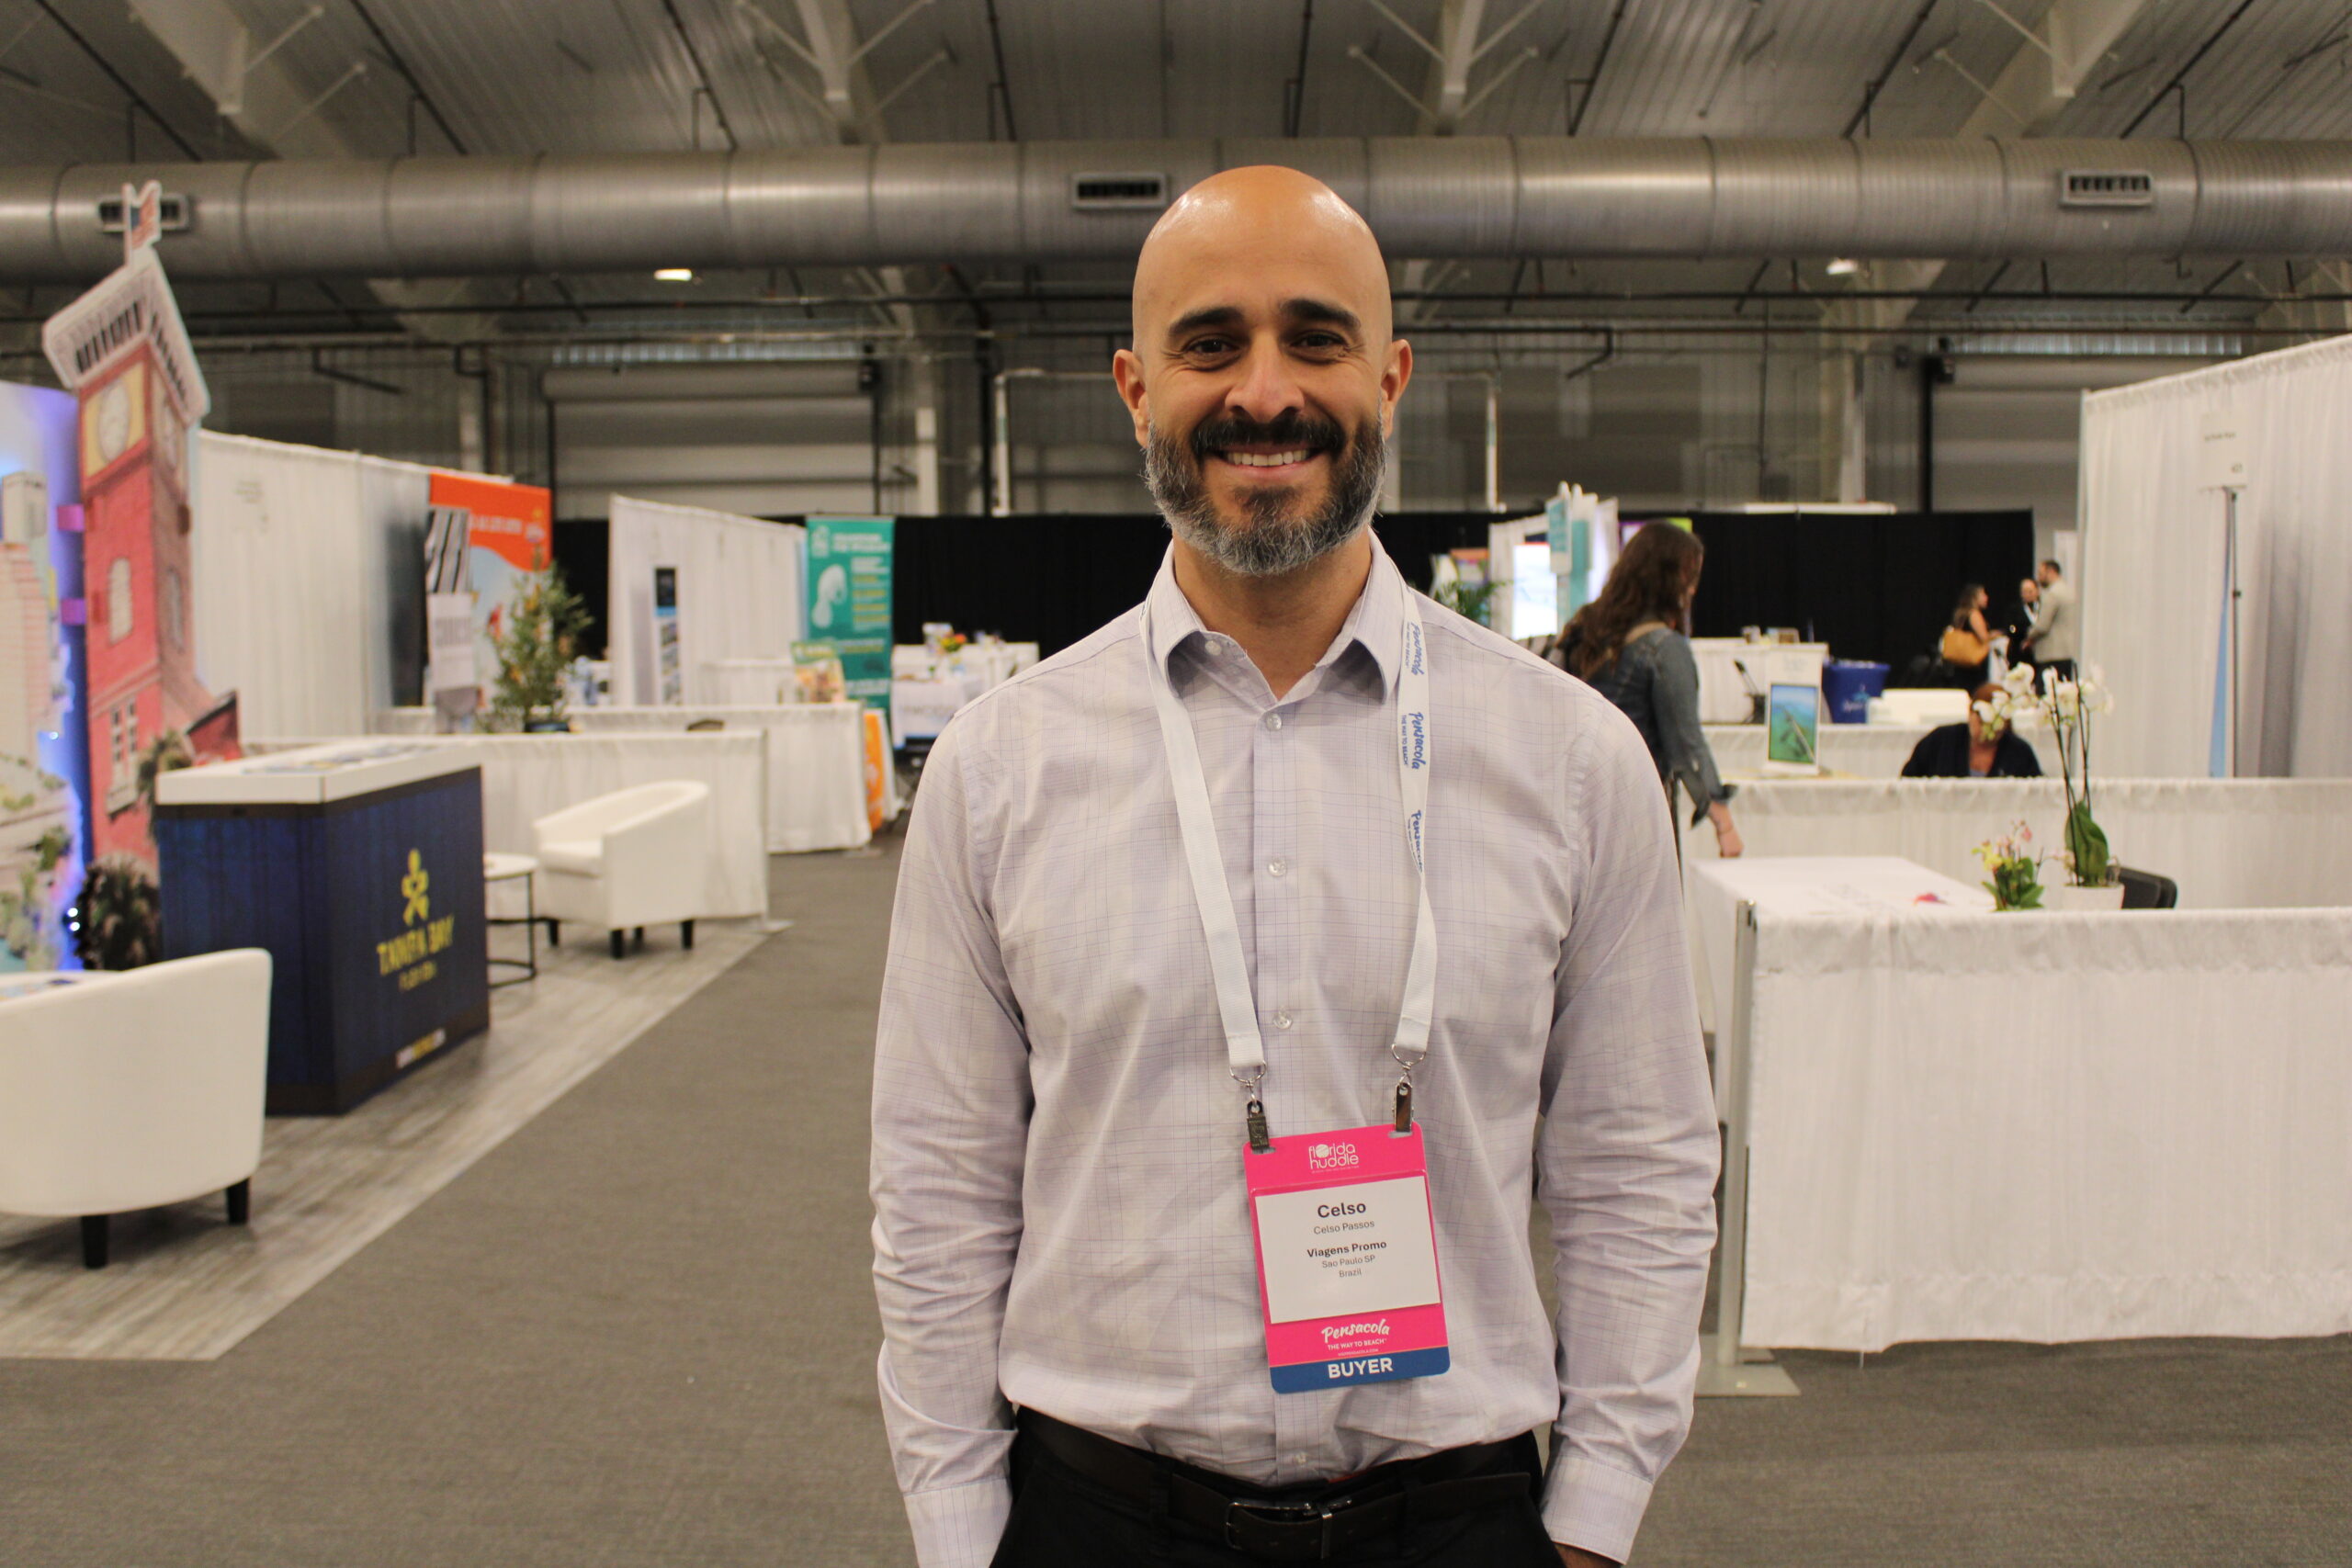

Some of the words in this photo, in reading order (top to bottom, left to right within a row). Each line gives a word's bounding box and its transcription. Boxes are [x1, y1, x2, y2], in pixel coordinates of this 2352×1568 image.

[1410, 622, 1424, 675] Pensacola
[1408, 711, 1426, 770] Pensacola
[1309, 1153, 1359, 1169] huddle
[1317, 1201, 1366, 1218] Celso
[1313, 1224, 1340, 1235] Celso
[1341, 1220, 1375, 1232] Passos
[1306, 1247, 1350, 1258] Viagens
[1351, 1241, 1387, 1253] Promo
[1322, 1259, 1338, 1269] Sao
[1339, 1256, 1363, 1267] Paulo
[1364, 1254, 1375, 1264] SP
[1339, 1268, 1363, 1278] Brazil
[1321, 1318, 1390, 1344] Pensacola
[1328, 1343, 1340, 1351] THE
[1328, 1357, 1394, 1379] BUYER
